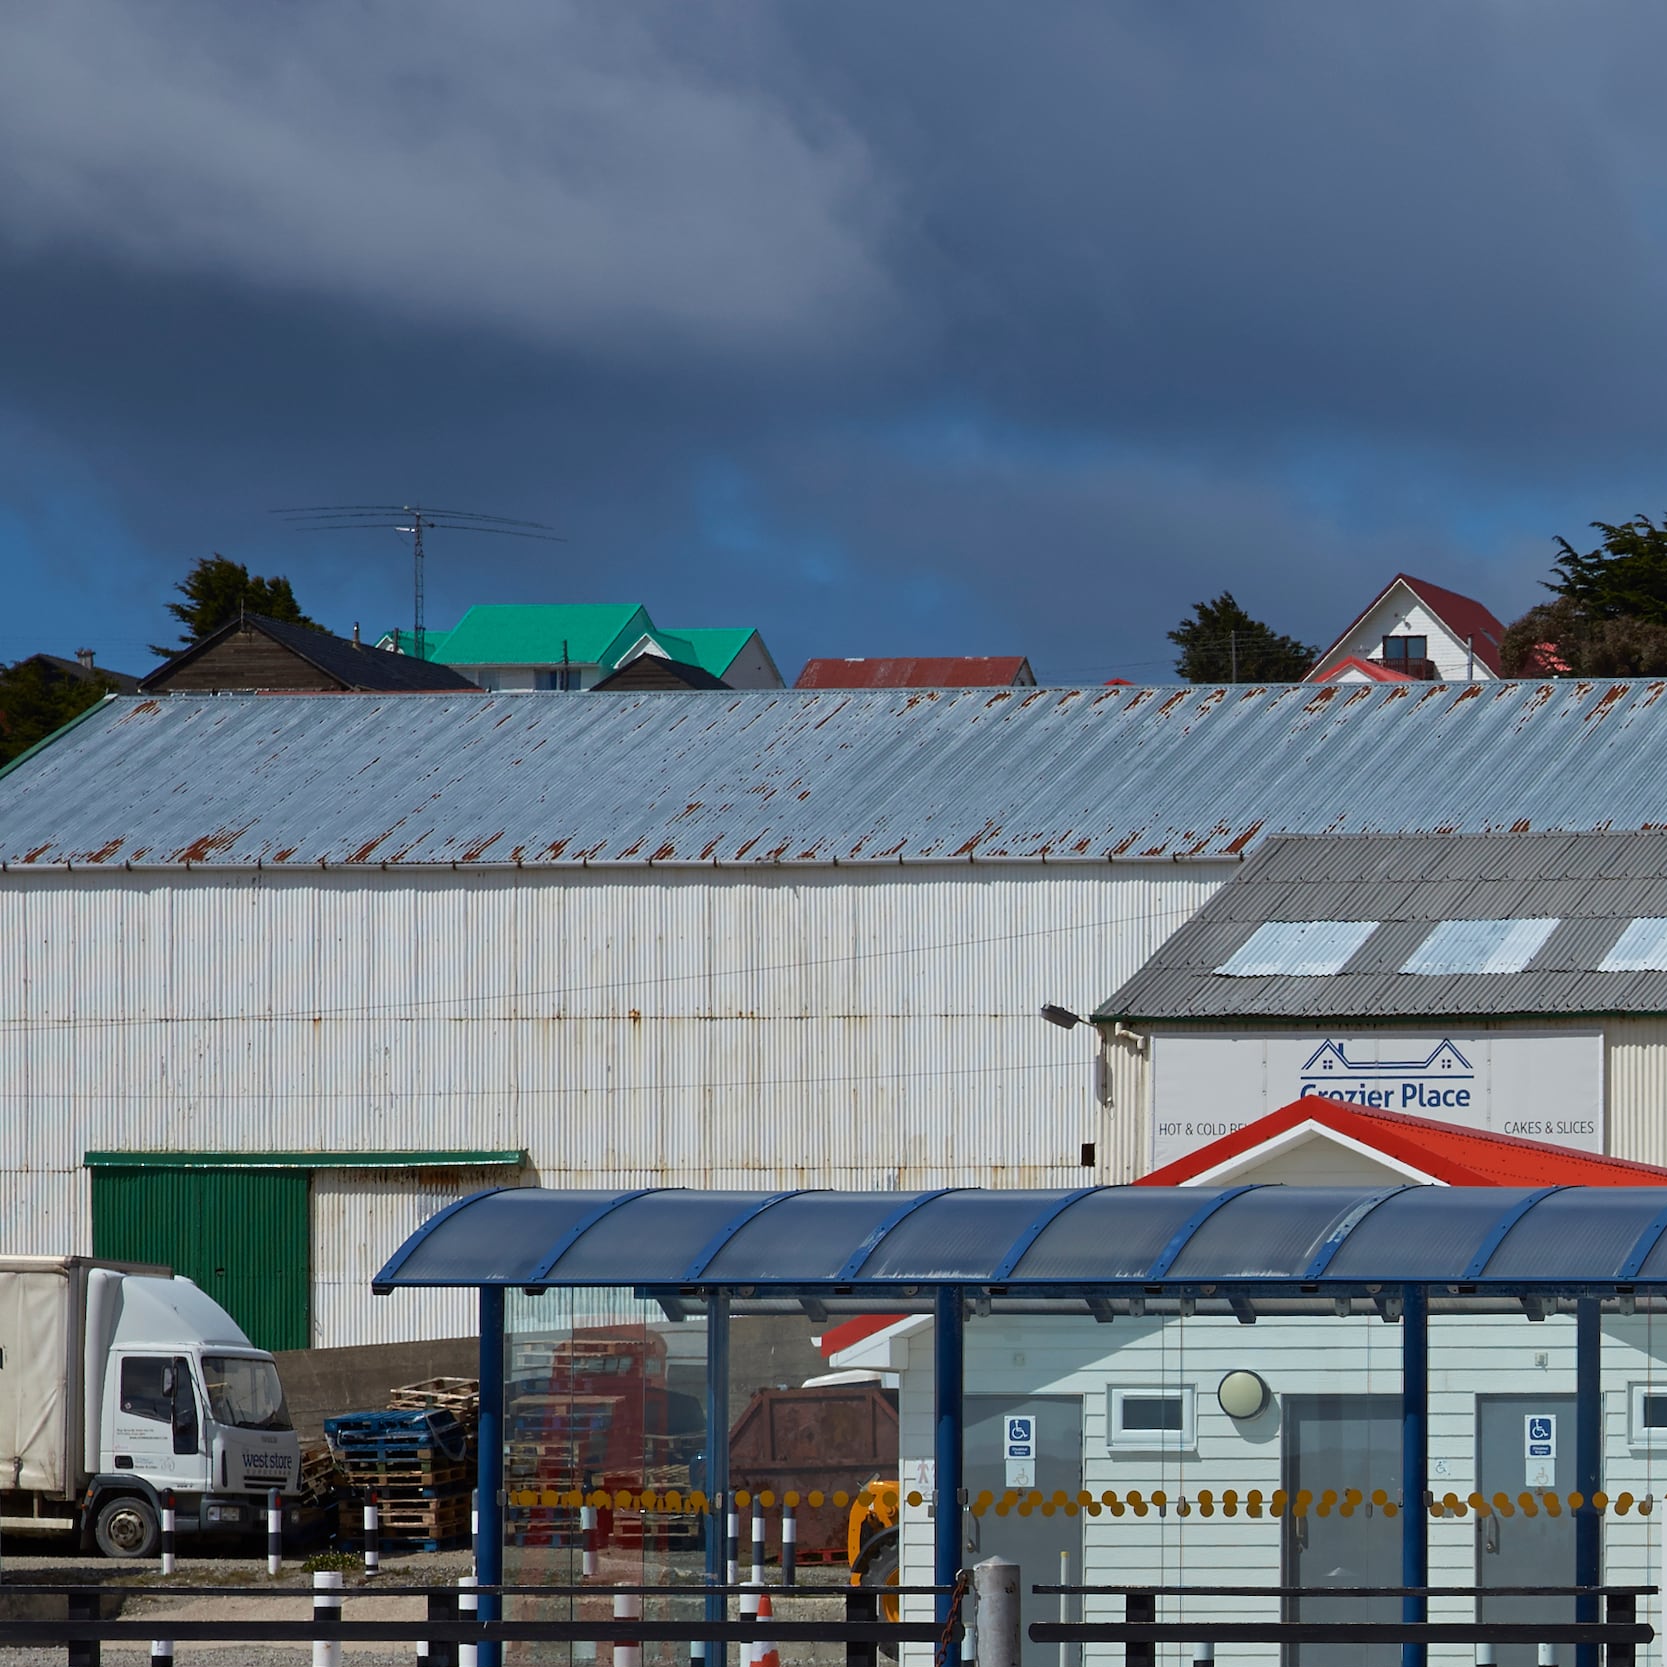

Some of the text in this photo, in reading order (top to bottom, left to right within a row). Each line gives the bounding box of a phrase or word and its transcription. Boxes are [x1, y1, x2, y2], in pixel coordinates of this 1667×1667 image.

[1401, 1083, 1471, 1108] Place
[1159, 1122, 1182, 1136] HOT
[1185, 1122, 1193, 1136] &
[1196, 1122, 1226, 1136] COLD
[1504, 1121, 1594, 1134] CAKES & SLICES
[242, 1452, 293, 1470] west store
